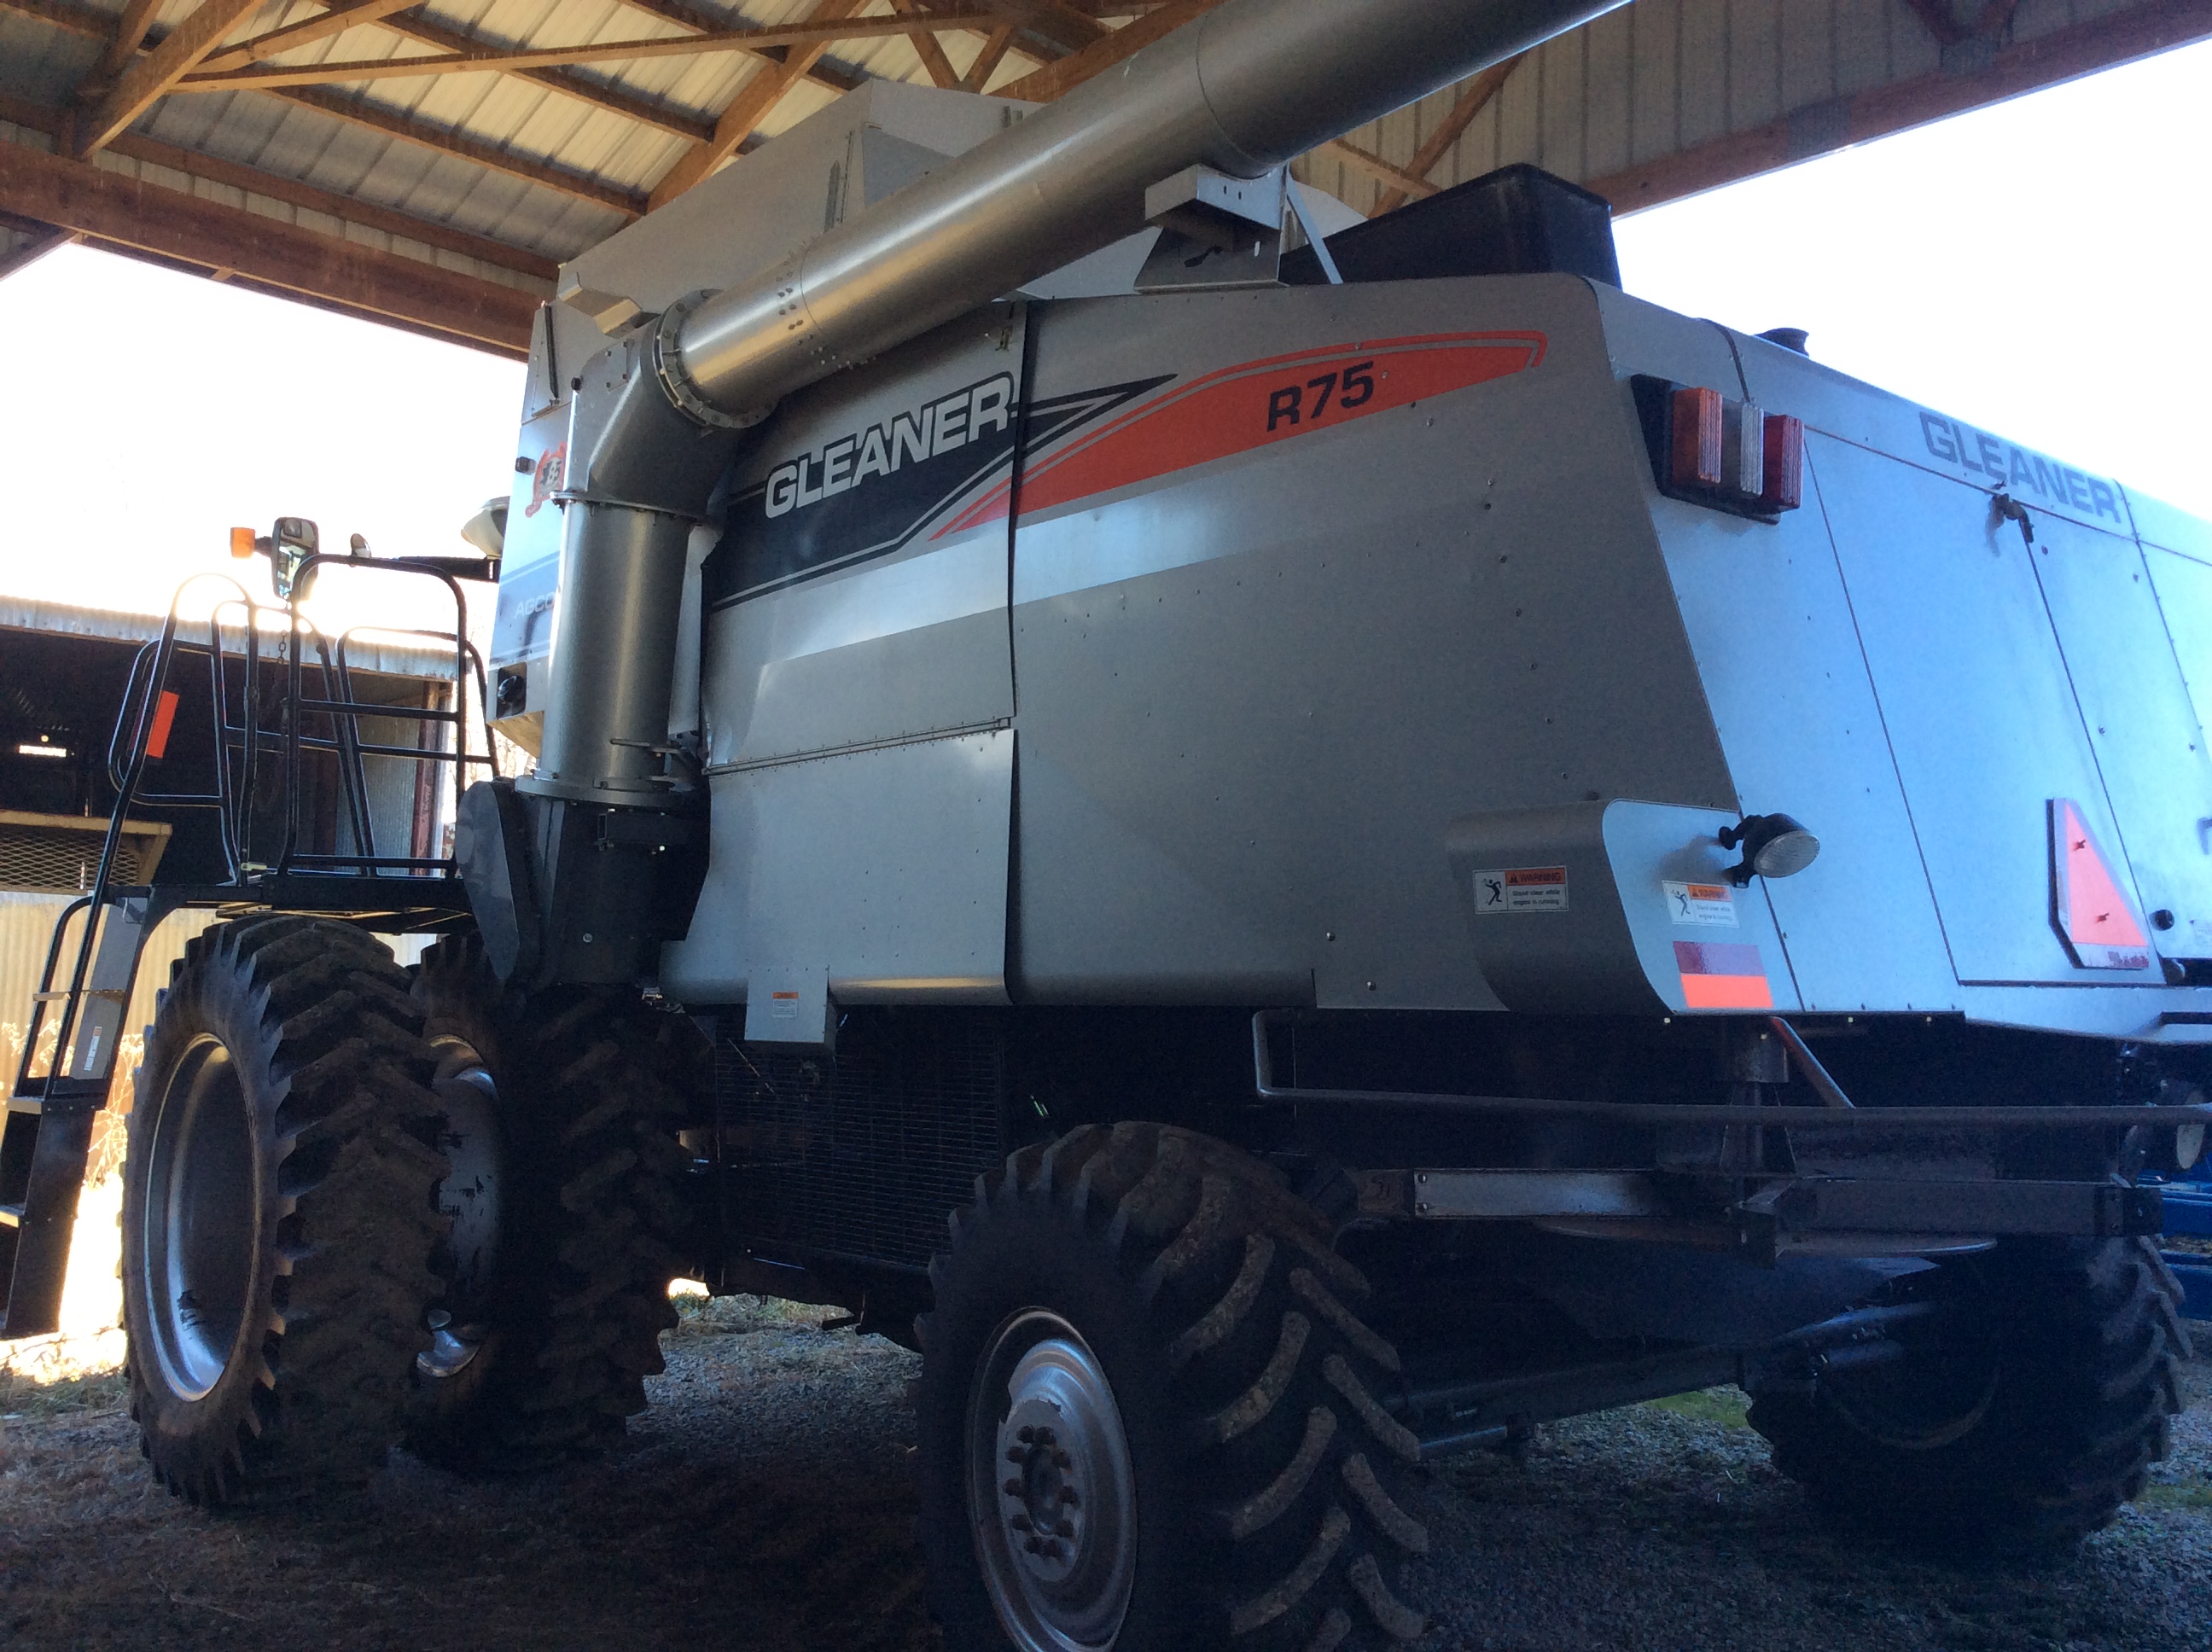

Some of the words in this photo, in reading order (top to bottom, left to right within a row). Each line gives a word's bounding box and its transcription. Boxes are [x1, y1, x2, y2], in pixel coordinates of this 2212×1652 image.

[1267, 361, 1374, 432] R75
[765, 375, 1011, 518] GLEANER
[1919, 411, 2121, 523] GLEANER
[514, 591, 556, 619] AGCO
